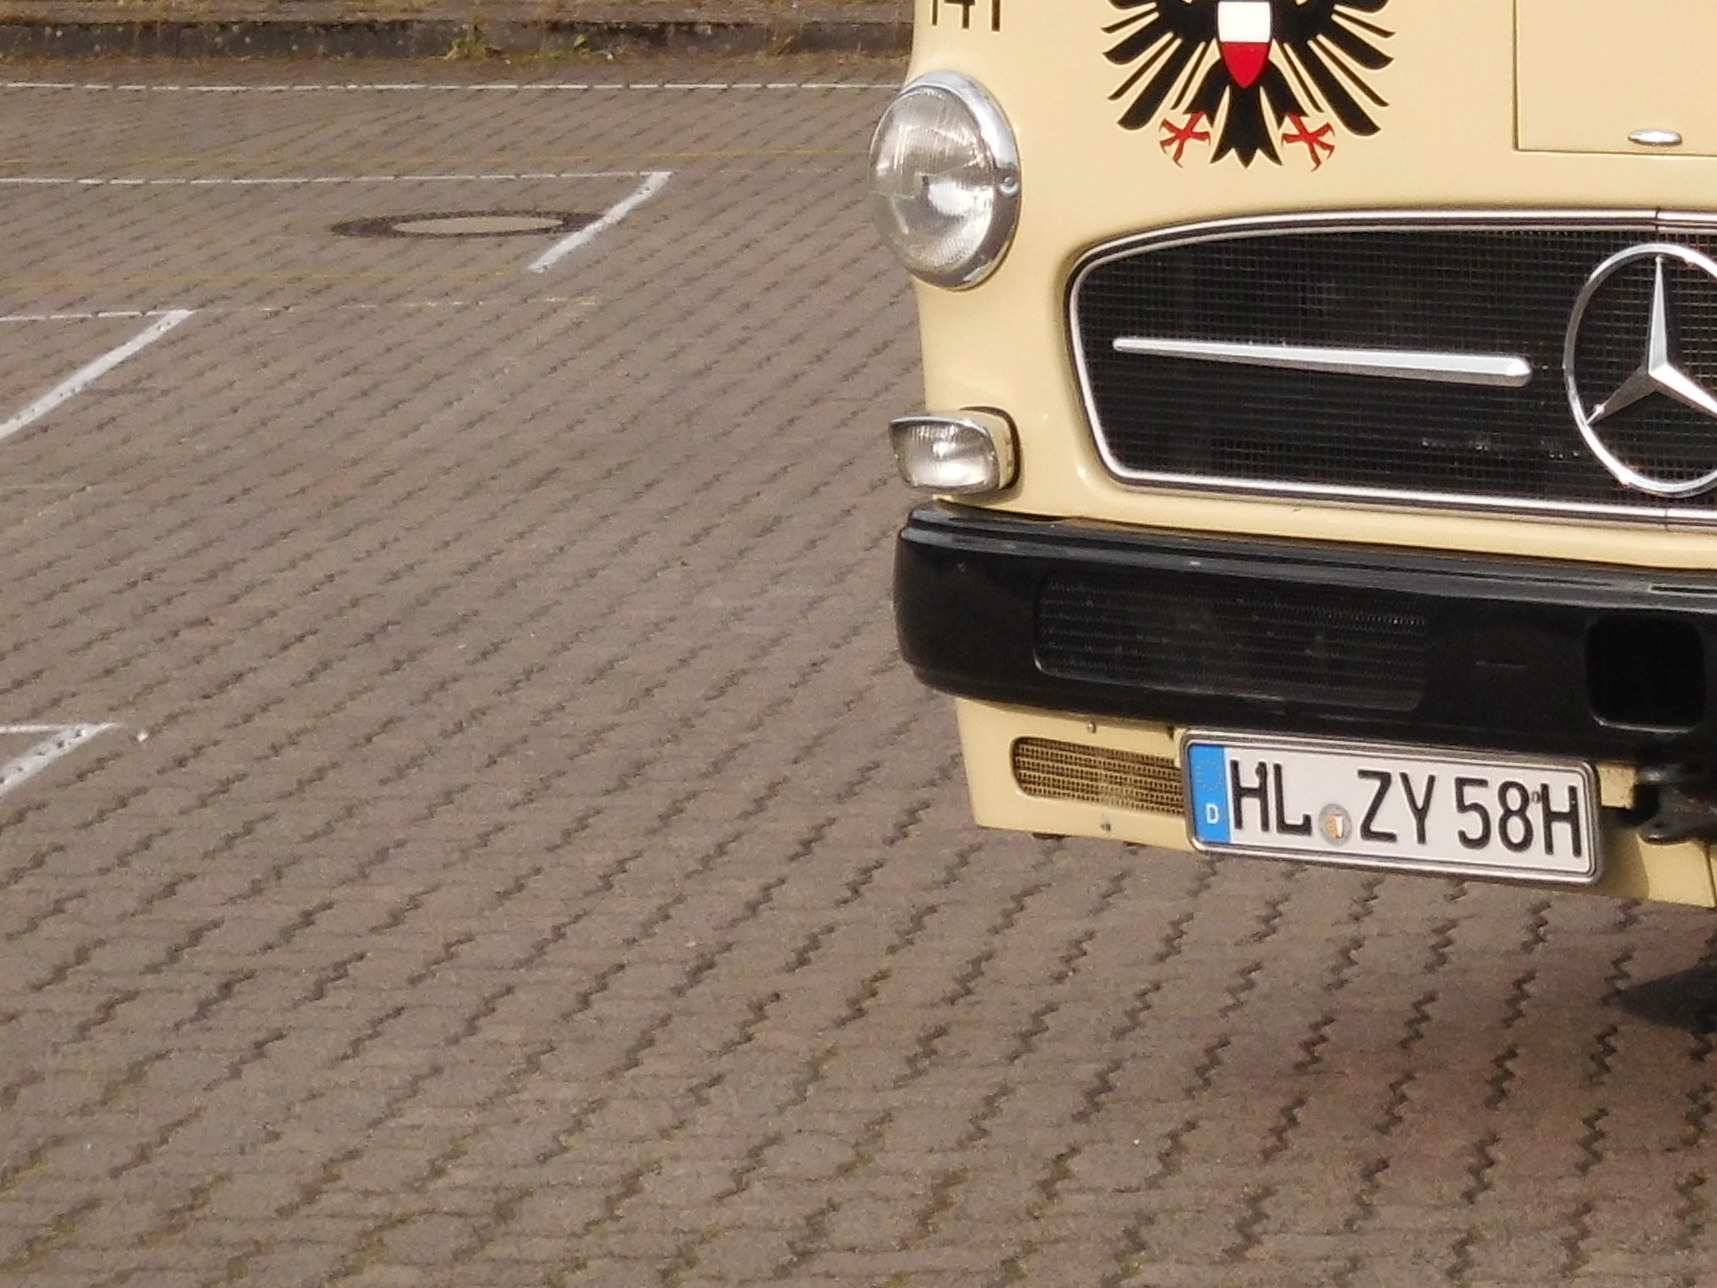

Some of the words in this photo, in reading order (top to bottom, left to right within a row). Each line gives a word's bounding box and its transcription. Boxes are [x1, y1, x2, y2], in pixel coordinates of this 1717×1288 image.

[1206, 803, 1219, 824] D
[1230, 759, 1312, 836] HL
[1355, 768, 1438, 847] ZY
[1455, 775, 1584, 858] 58H
